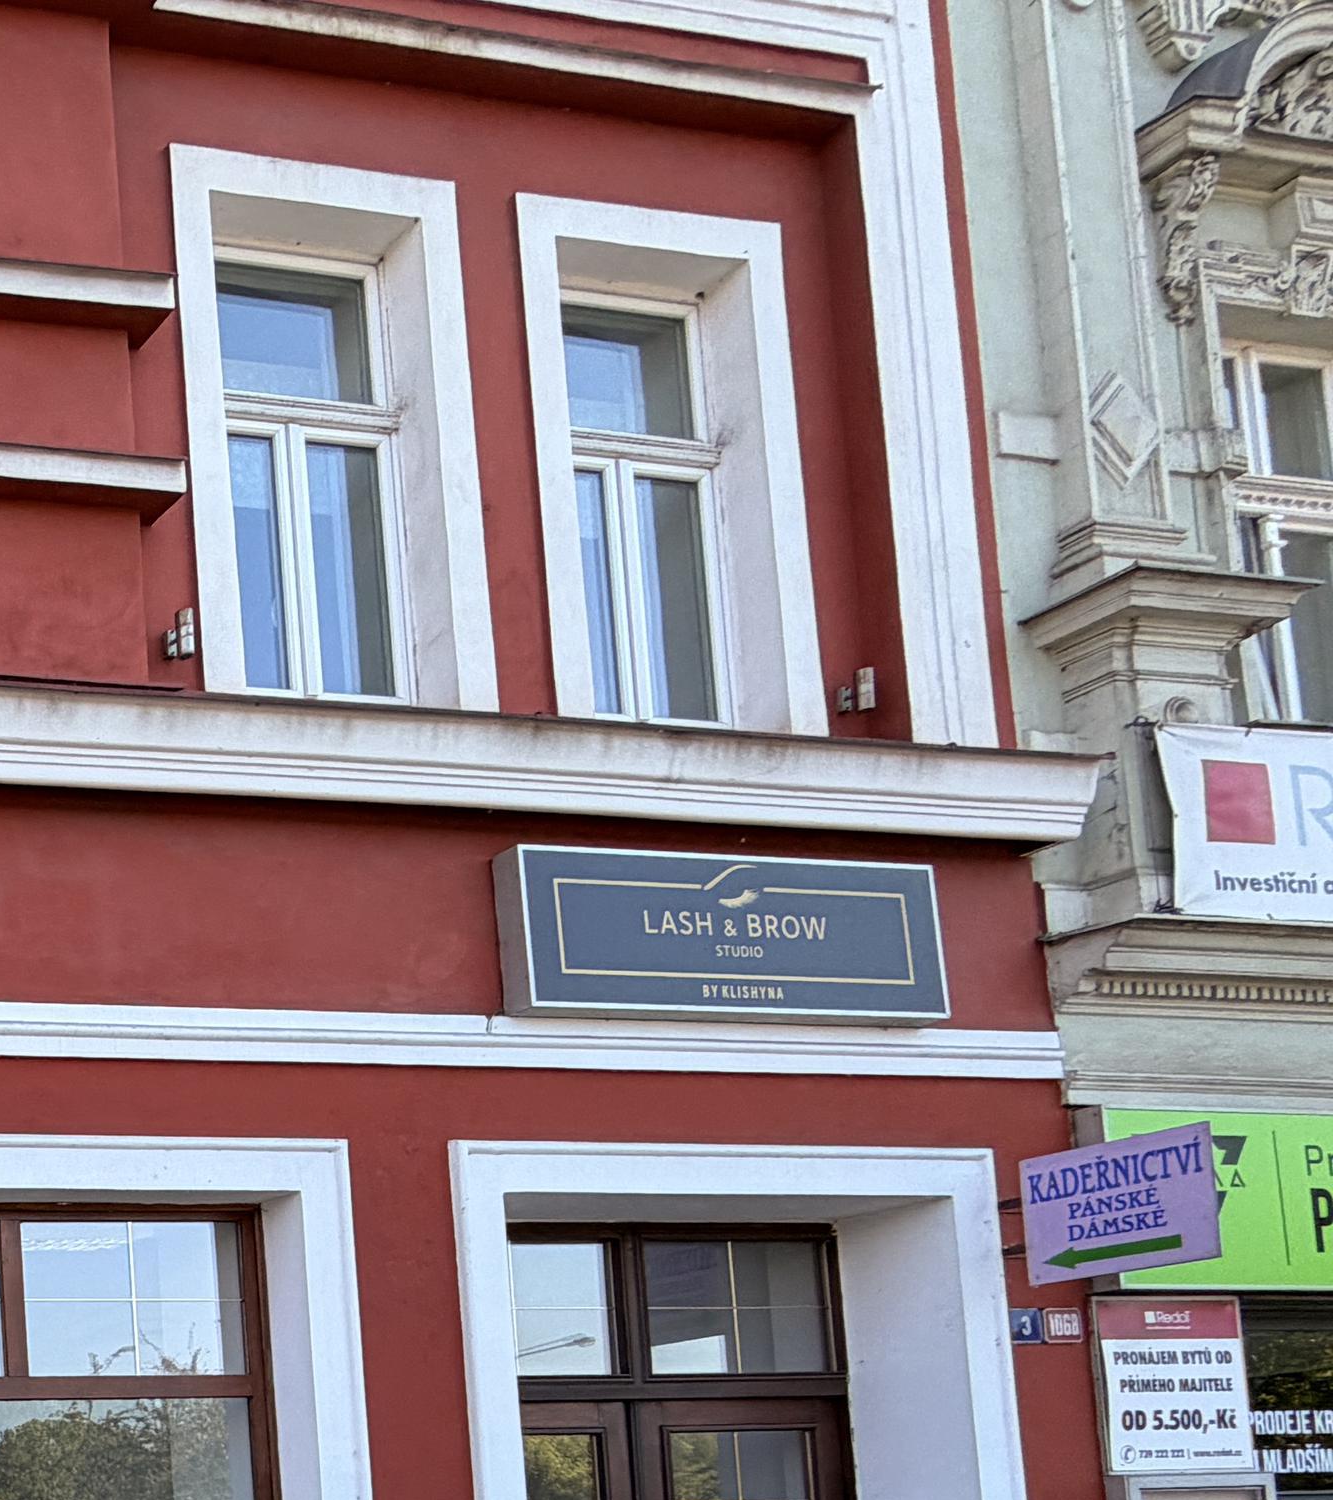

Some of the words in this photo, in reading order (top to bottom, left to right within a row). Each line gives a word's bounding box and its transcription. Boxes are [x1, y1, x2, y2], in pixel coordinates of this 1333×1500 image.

[1214, 870, 1318, 895] Investiční
[643, 909, 714, 937] LASH
[723, 918, 738, 938] &
[746, 913, 827, 941] BROW
[715, 944, 764, 959] STUDIO
[702, 984, 719, 998] BY
[721, 985, 785, 1000] KLISHYNA
[1027, 1135, 1204, 1206] KADEŘNICTVÍ
[1067, 1184, 1161, 1231] PÁNSKÉ
[1067, 1204, 1168, 1242] DÁMSKÉ
[1020, 1315, 1033, 1336] 3
[1113, 1346, 1179, 1366] PRONÁJEM
[1181, 1346, 1212, 1365] BYTŮ
[1215, 1350, 1233, 1365] OD
[1119, 1373, 1175, 1393] PŘÍMÉHO
[1178, 1377, 1234, 1393] MAJITELE
[1121, 1409, 1147, 1431] OD
[1151, 1408, 1237, 1434] 5.500,-Kč
